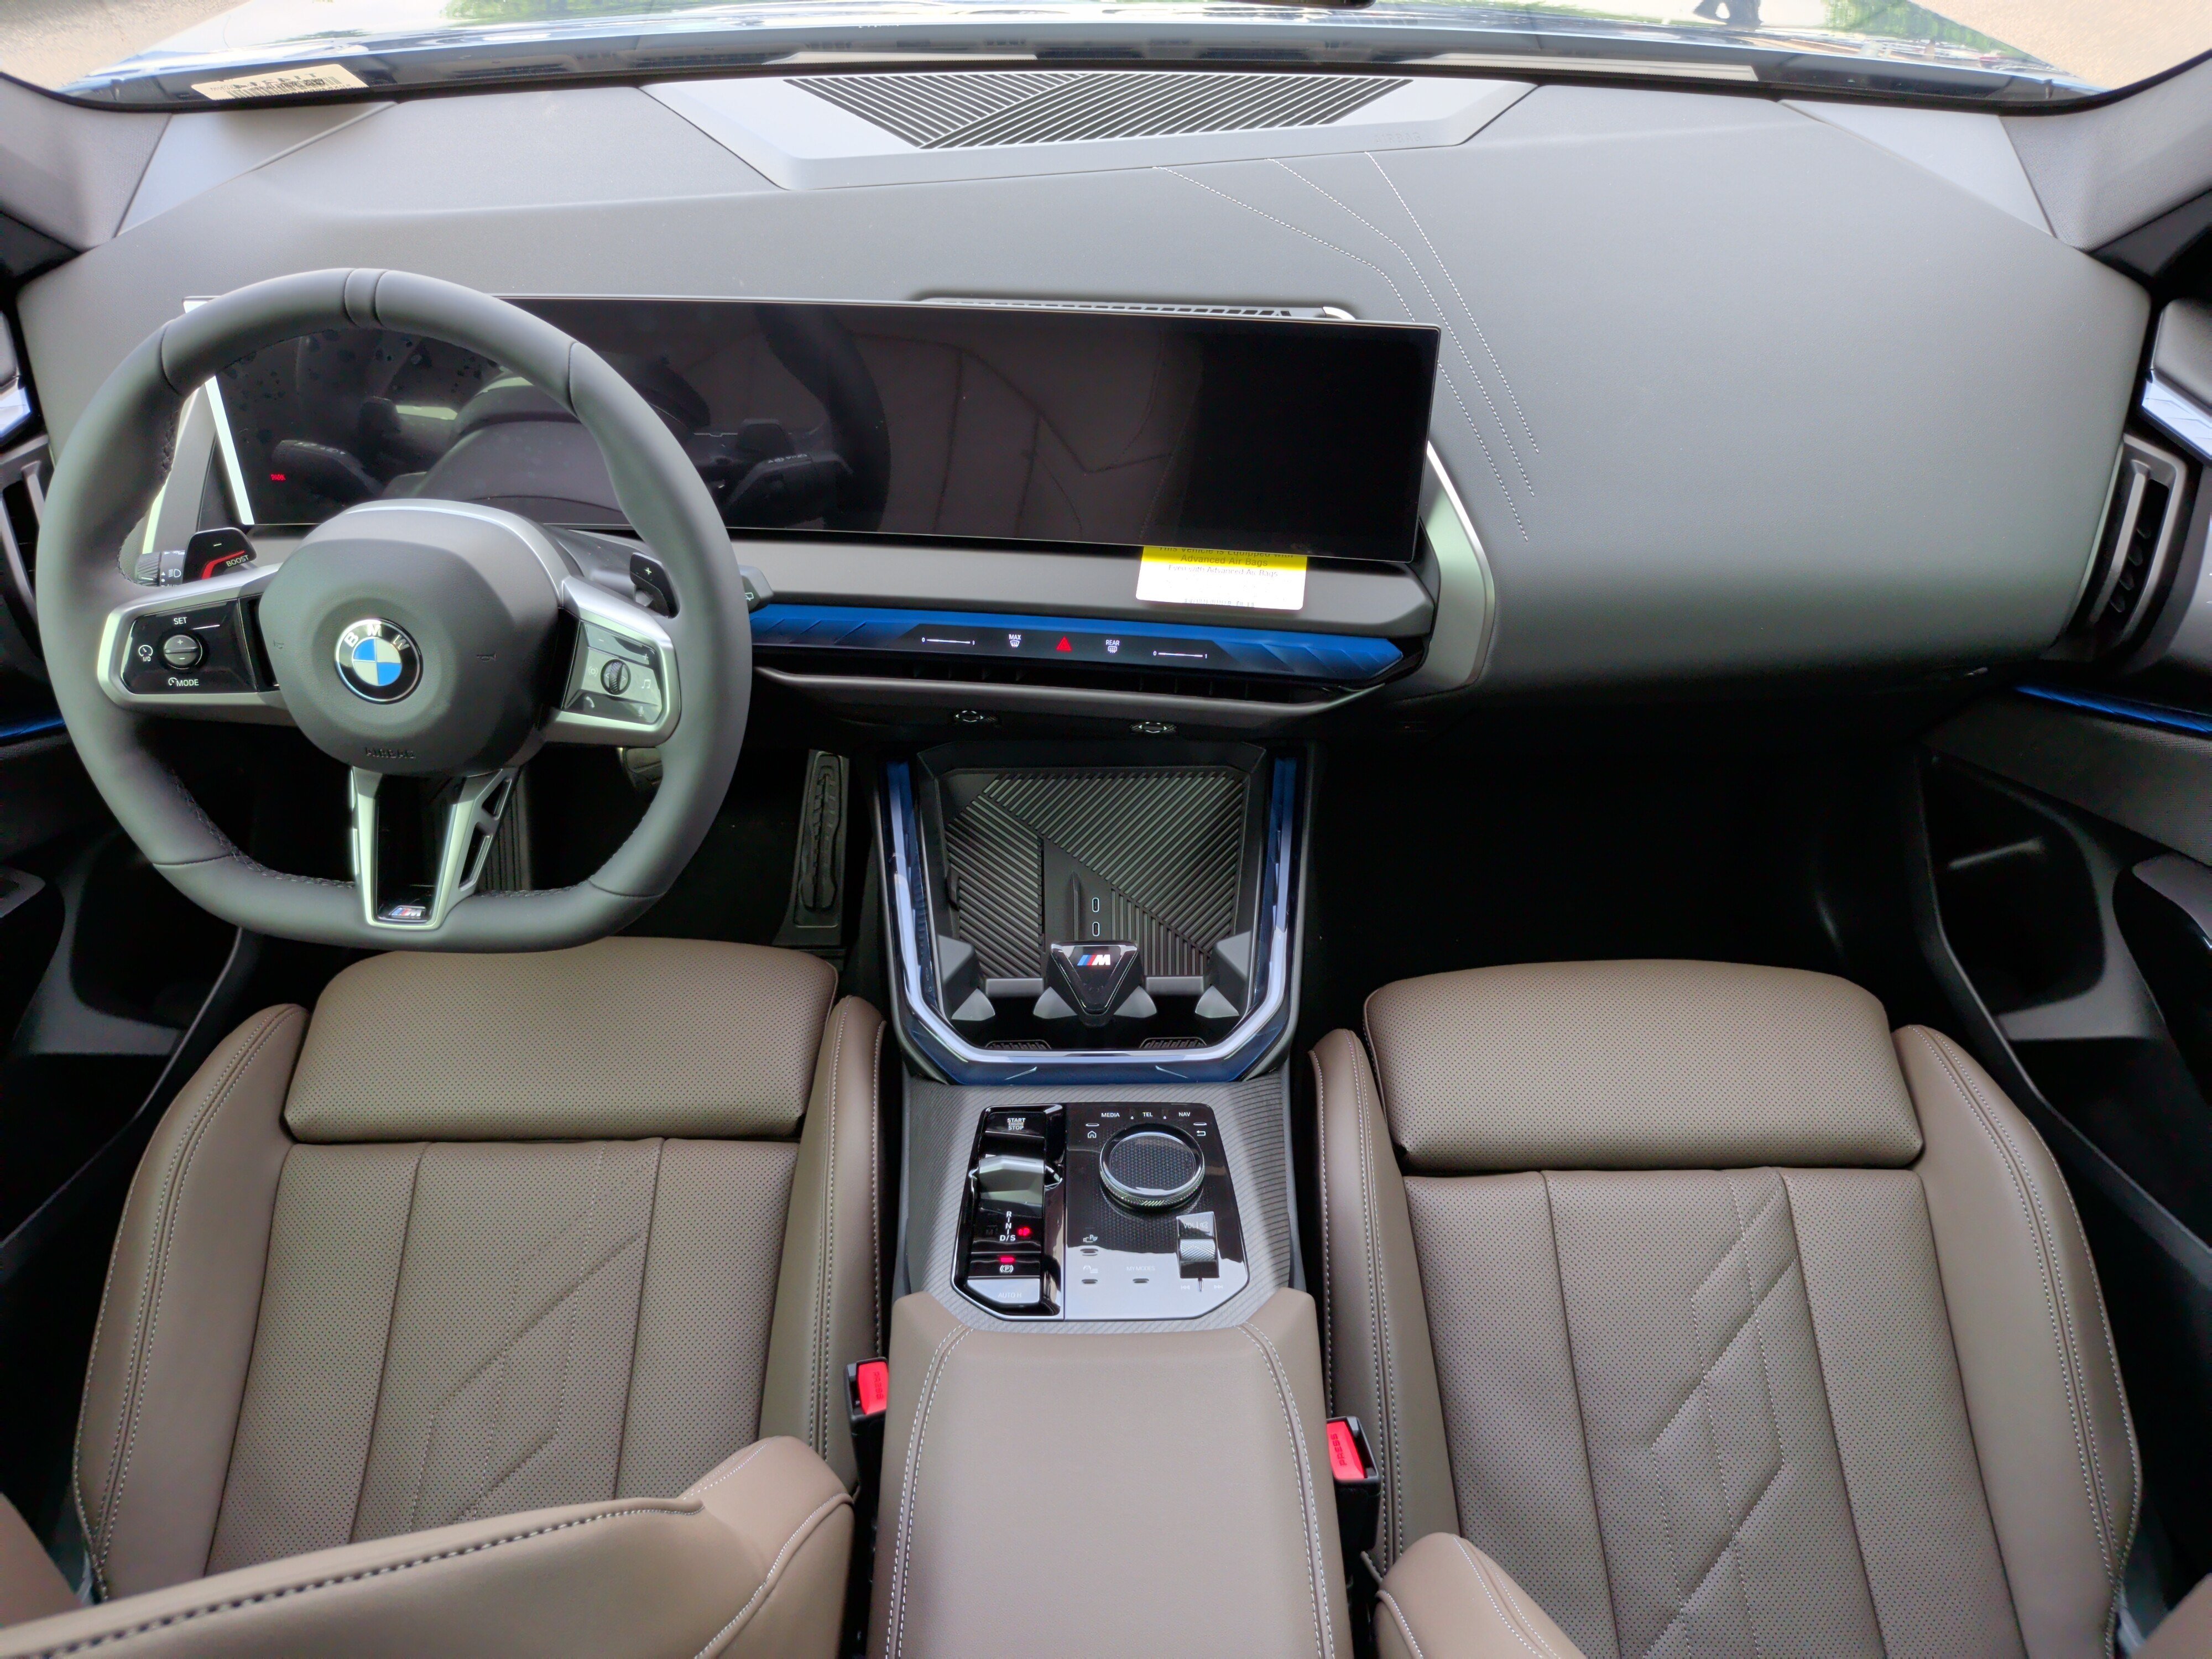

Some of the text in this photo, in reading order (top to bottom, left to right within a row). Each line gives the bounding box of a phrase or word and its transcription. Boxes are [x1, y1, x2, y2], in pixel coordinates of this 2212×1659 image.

[226, 555, 249, 567] BOOST
[1180, 554, 1226, 564] Advanced
[1245, 558, 1269, 567] Bags
[174, 617, 187, 625] SET
[344, 623, 410, 651] BMW
[176, 679, 200, 687] MODE
[873, 1371, 885, 1400] PRESS
[1331, 1433, 1347, 1466] PRESS
